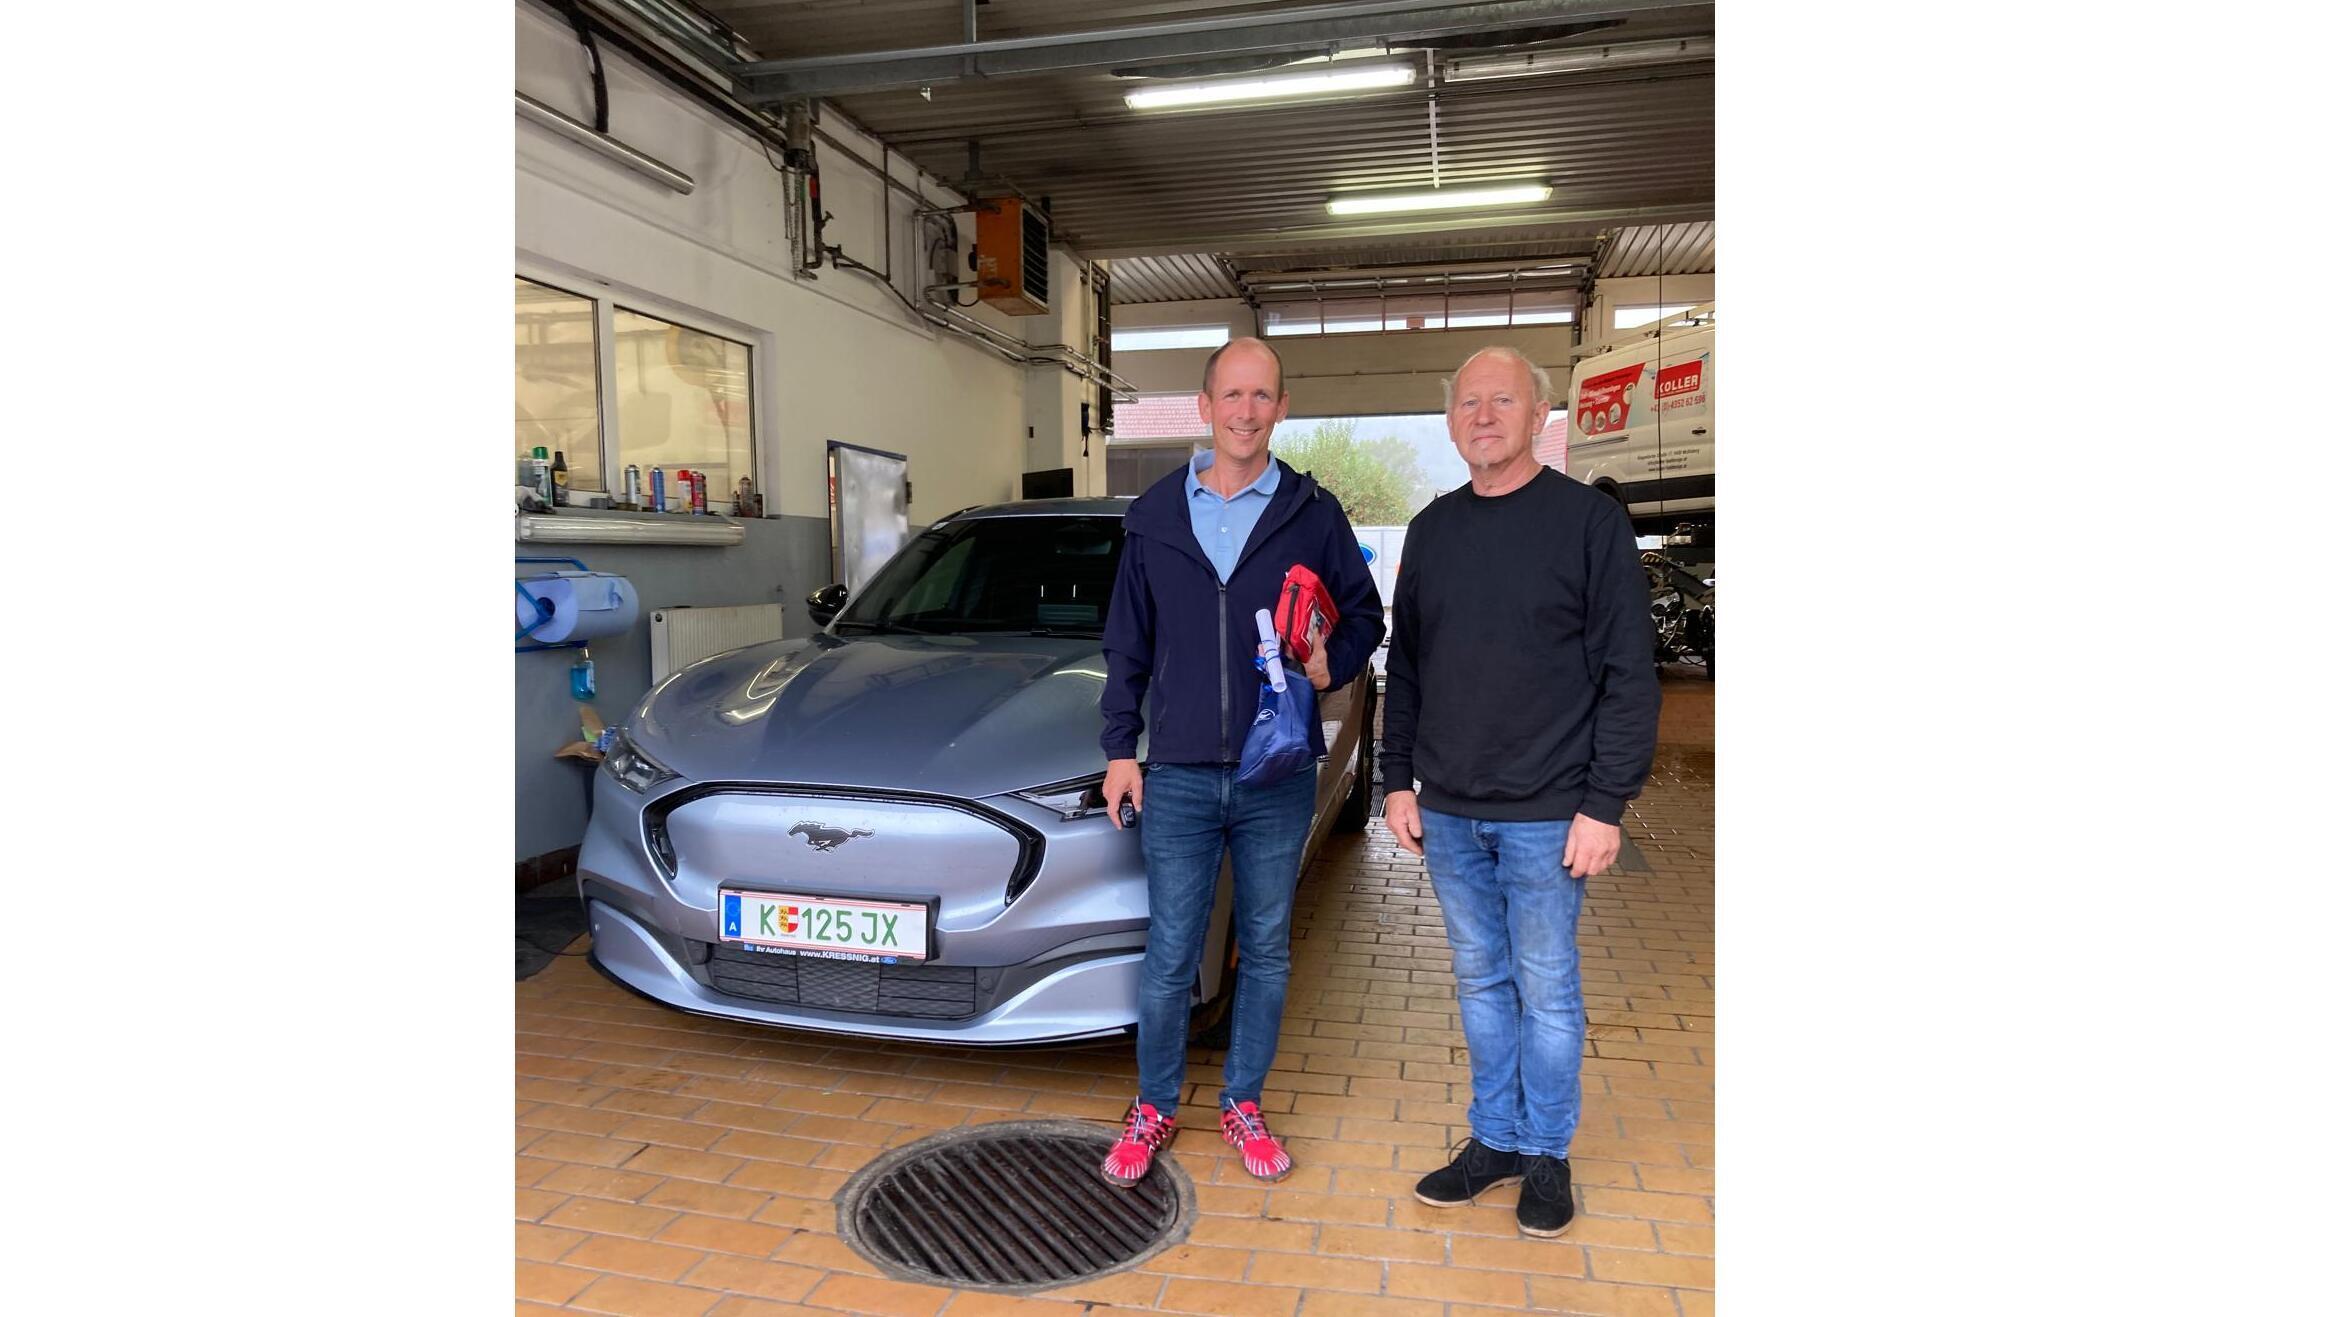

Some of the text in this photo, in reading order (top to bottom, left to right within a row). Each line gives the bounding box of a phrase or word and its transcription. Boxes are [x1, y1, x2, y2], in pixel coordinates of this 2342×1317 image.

[1659, 374, 1699, 393] KOLLER
[729, 922, 737, 932] A
[760, 904, 898, 946] K 125 JX
[765, 946, 796, 956] Autohaus
[799, 950, 880, 963] www.KRESSNIG.at
